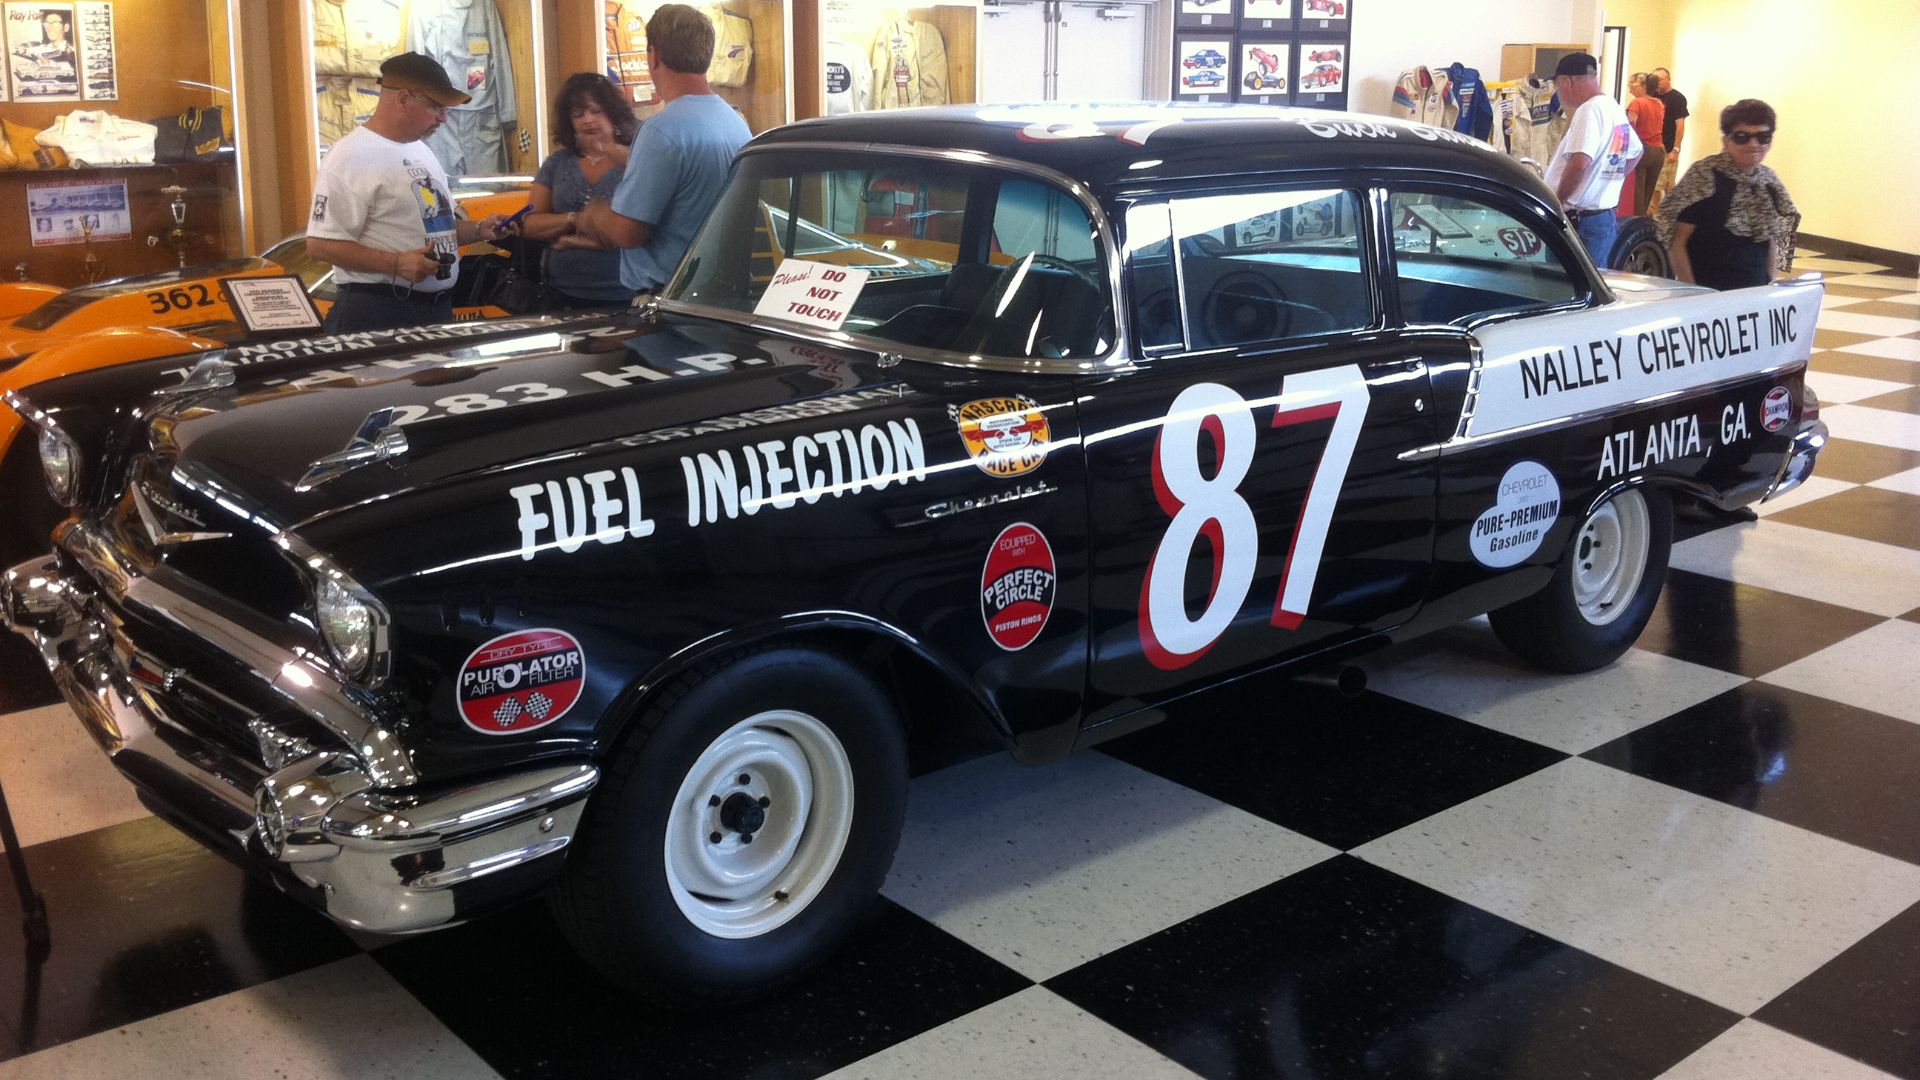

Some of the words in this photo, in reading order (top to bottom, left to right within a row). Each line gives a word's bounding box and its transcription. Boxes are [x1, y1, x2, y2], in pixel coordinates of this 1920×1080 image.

[1502, 228, 1538, 254] STP
[773, 265, 814, 288] Please!
[821, 269, 847, 283] DO
[147, 284, 216, 314] 362
[806, 286, 843, 302] NOT
[787, 302, 843, 322] TOUCH
[1519, 337, 1622, 399] NALLEY
[1637, 311, 1759, 375] CHEVROLET
[1769, 304, 1798, 347] INC
[391, 383, 568, 426] 283
[581, 353, 767, 388] H.P.
[1720, 401, 1752, 445] GA.
[509, 467, 655, 561] FUEL
[680, 418, 926, 527] INJECTION
[1502, 474, 1548, 496] CHEVROLET
[925, 480, 1058, 519] Chevrolet
[1138, 364, 1371, 671] 87
[1476, 499, 1558, 538] PURE-PREMIUM
[1000, 534, 1036, 551] EQUIPPED
[1490, 529, 1539, 552] Gasoline
[984, 568, 1054, 604] PERFECT
[995, 584, 1043, 610] CIRCLE
[995, 618, 1020, 632] PISTON
[1021, 614, 1042, 626] RINGS
[490, 647, 516, 660] DRY
[523, 640, 553, 652] TYPE
[470, 682, 495, 697] AIR
[529, 664, 575, 685] FILTER
